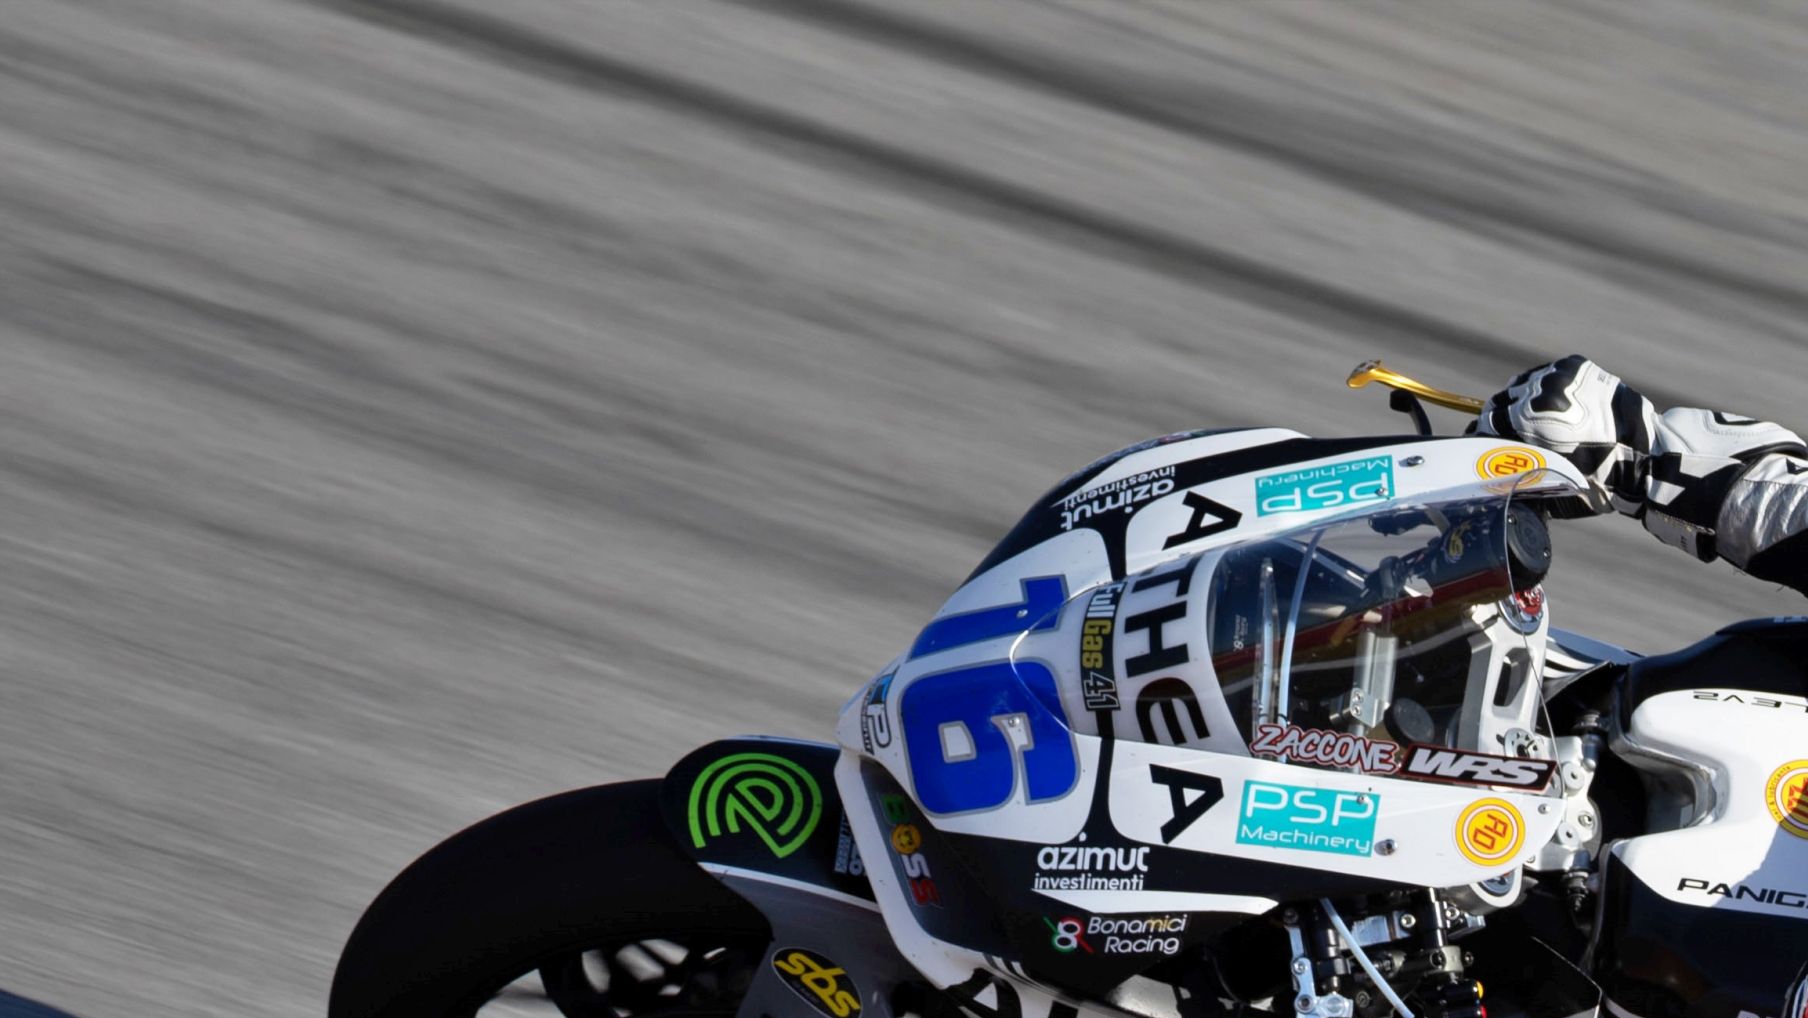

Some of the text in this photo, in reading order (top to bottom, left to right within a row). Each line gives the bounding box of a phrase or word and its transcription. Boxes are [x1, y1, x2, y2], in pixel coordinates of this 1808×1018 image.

[1258, 456, 1389, 489] Machinery
[1261, 472, 1390, 512] PSP
[1059, 478, 1175, 531] azimut
[1081, 618, 1113, 669] Gas
[900, 574, 1082, 819] 16
[1083, 670, 1119, 711] 41
[1252, 724, 1548, 785] ZACCONE WRS
[1245, 784, 1375, 827] PSP
[1036, 832, 1151, 872] azimut
[1240, 825, 1371, 855] Machinery
[1033, 873, 1145, 891] investimenti
[1087, 914, 1188, 935] Bonamici
[1104, 935, 1180, 955] Racing
